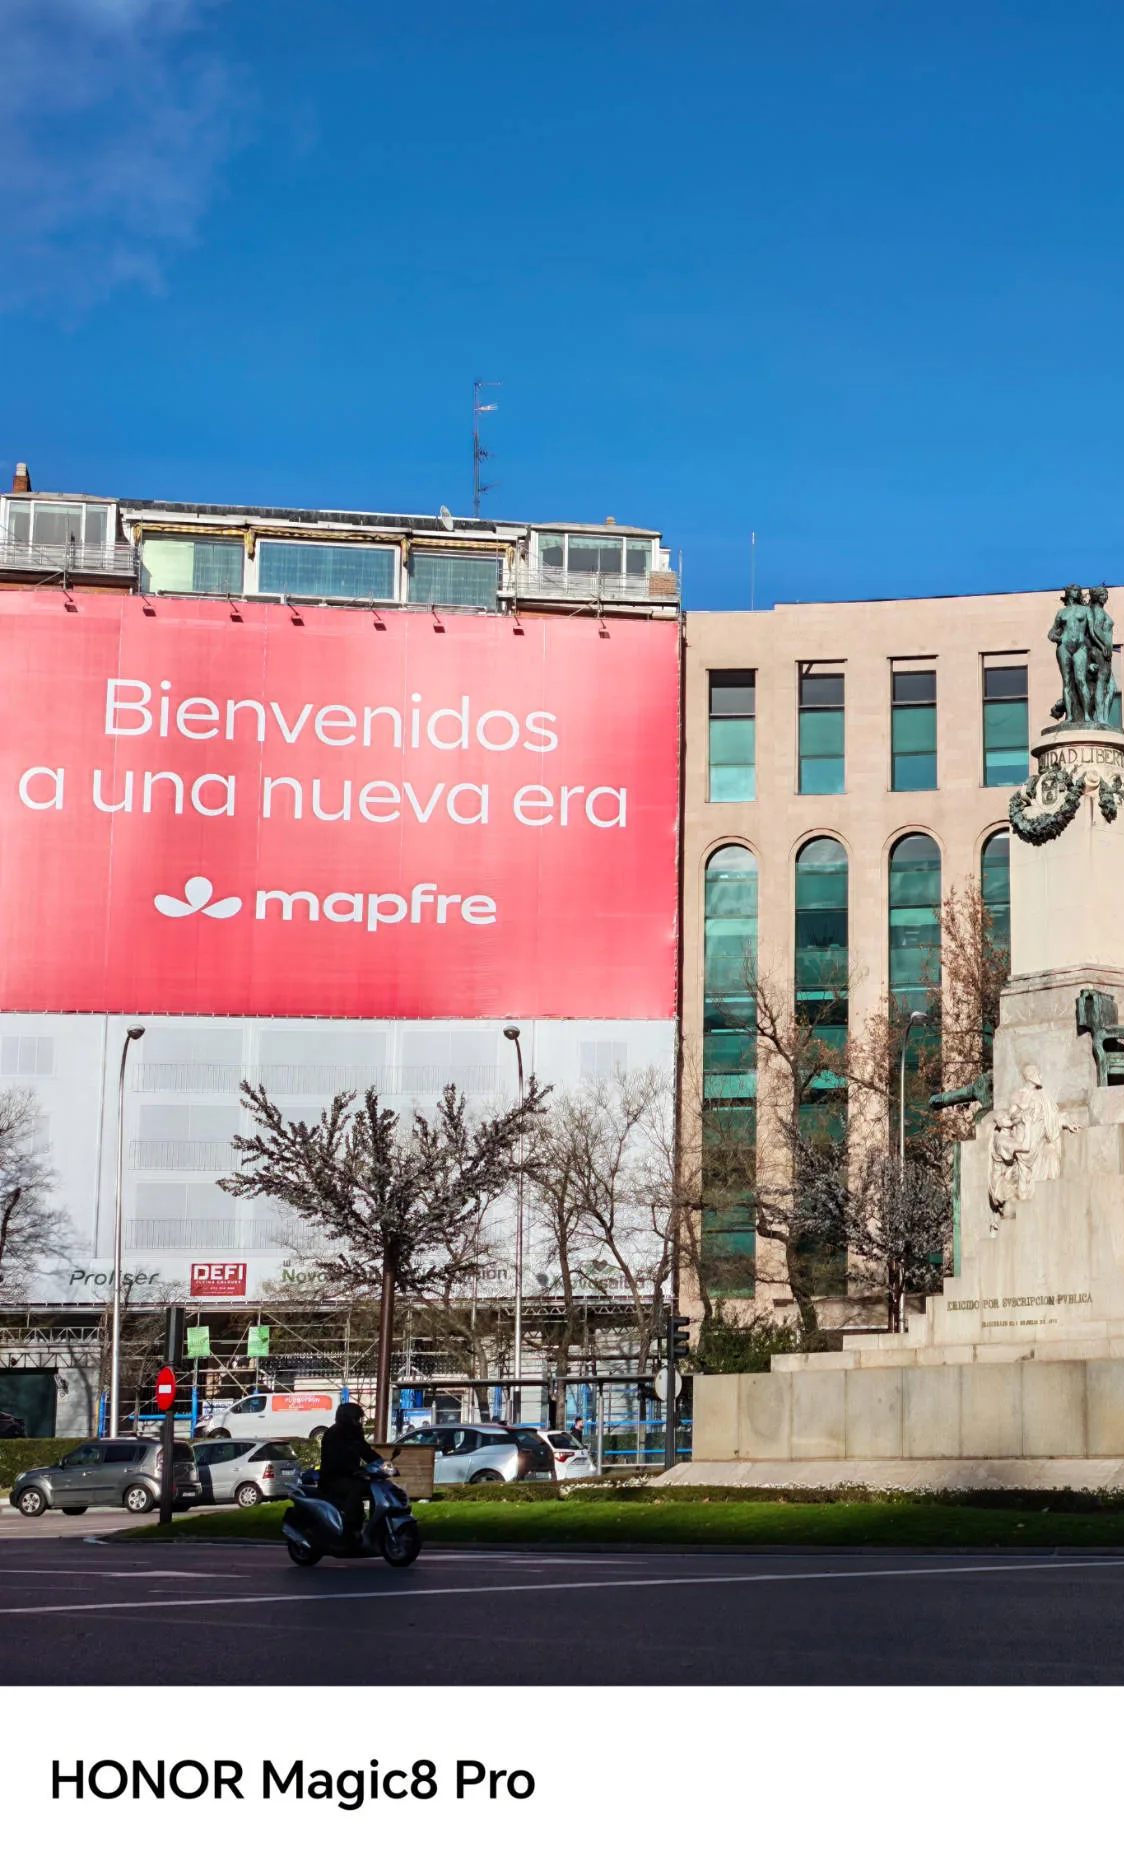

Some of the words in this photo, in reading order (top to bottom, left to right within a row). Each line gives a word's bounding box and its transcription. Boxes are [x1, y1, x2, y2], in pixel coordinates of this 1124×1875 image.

[104, 678, 559, 753] Bienvenidos
[18, 766, 65, 811] a
[92, 769, 236, 817] una
[262, 776, 490, 825] nueva
[513, 784, 628, 828] era
[255, 883, 498, 932] mapfre
[193, 1264, 244, 1280] DEFI
